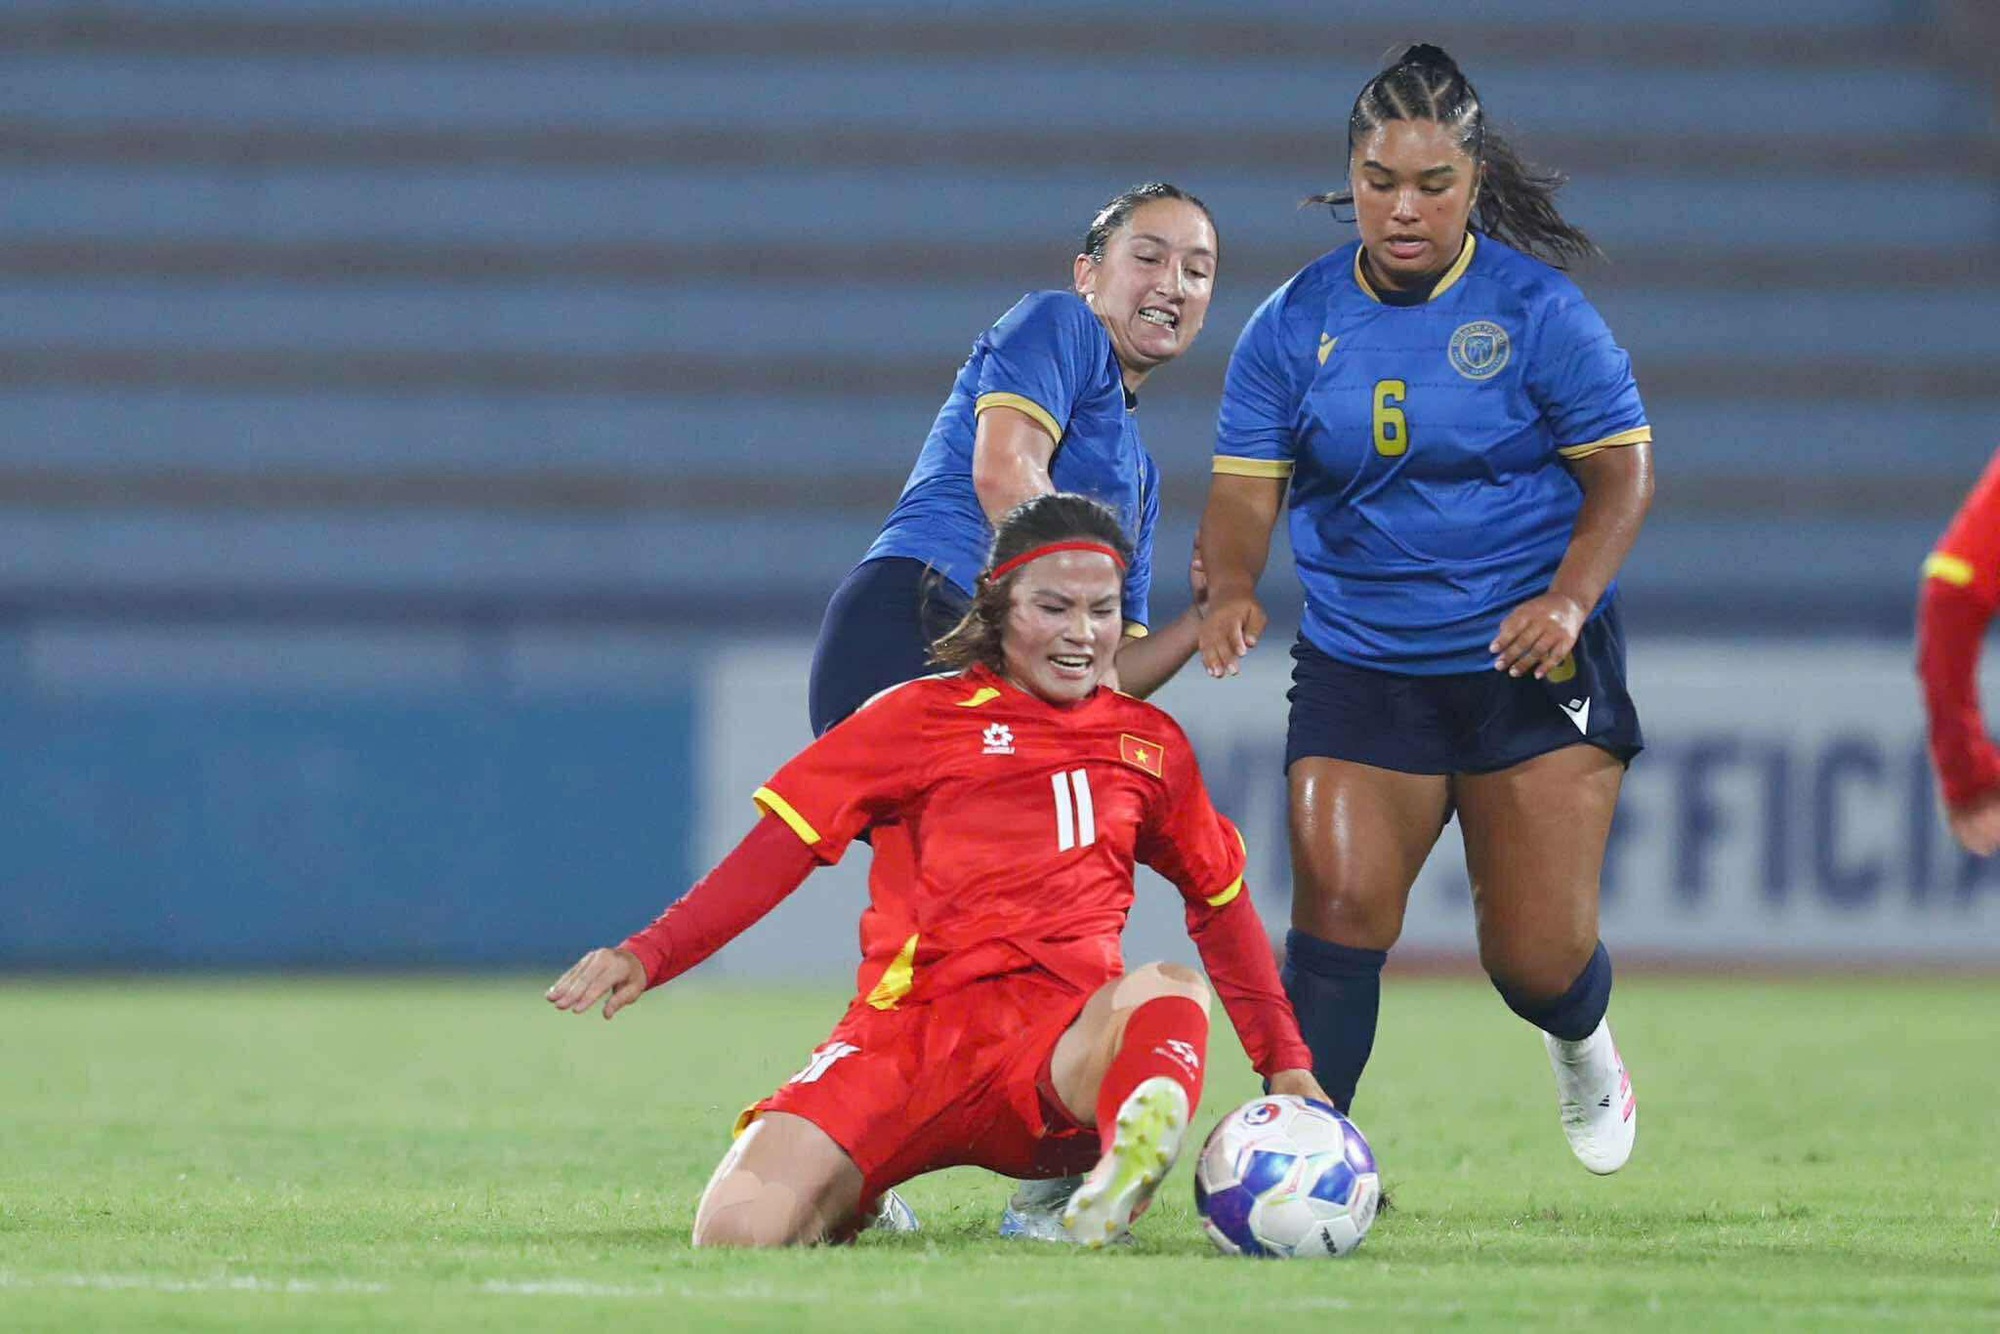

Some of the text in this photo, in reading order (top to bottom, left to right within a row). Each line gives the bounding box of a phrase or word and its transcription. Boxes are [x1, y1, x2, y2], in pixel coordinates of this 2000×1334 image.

[1373, 379, 1408, 457] 6
[1051, 768, 1096, 852] 11
[1598, 733, 2000, 905] FFICI
